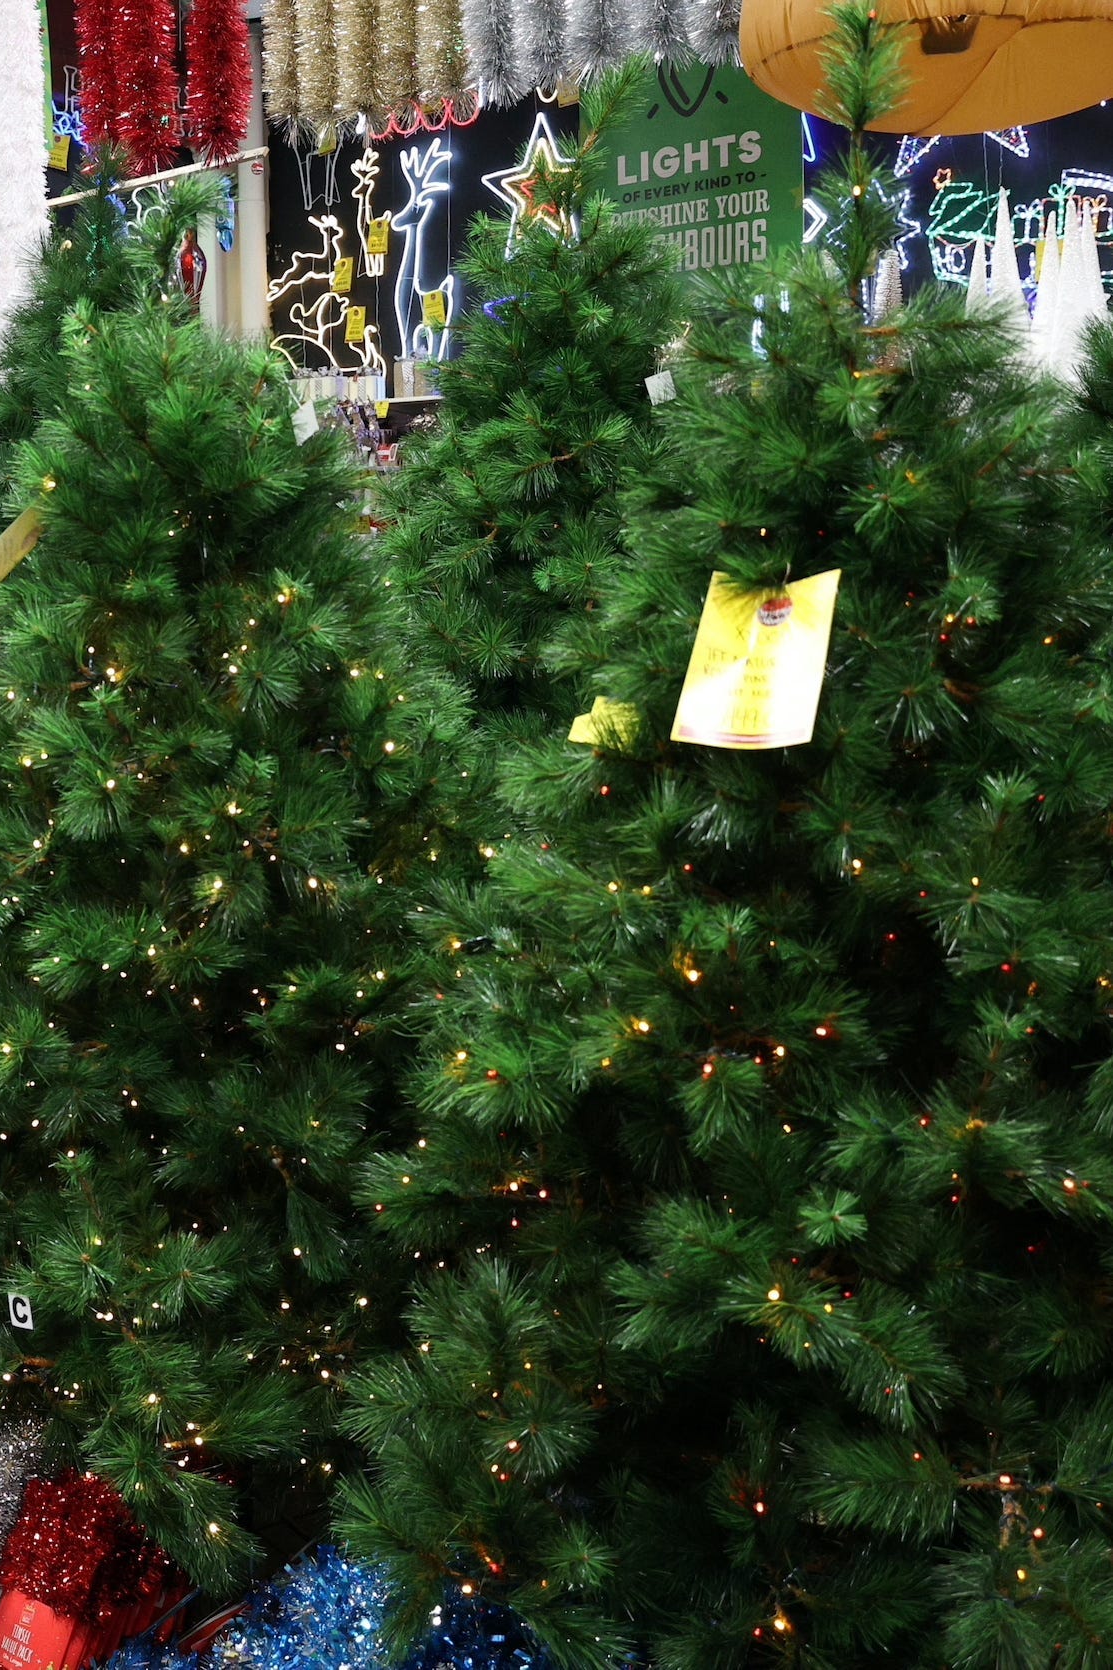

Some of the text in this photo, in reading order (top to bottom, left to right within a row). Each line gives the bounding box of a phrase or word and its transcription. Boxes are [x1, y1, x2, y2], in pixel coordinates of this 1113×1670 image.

[617, 130, 762, 186] LIGHTS
[622, 170, 756, 204] OF EVERY KIND TO
[714, 189, 770, 221] YOUR
[12, 1296, 28, 1324] C
[1, 1635, 34, 1664] VALUE PACK
[12, 1624, 31, 1645] TINSEL
